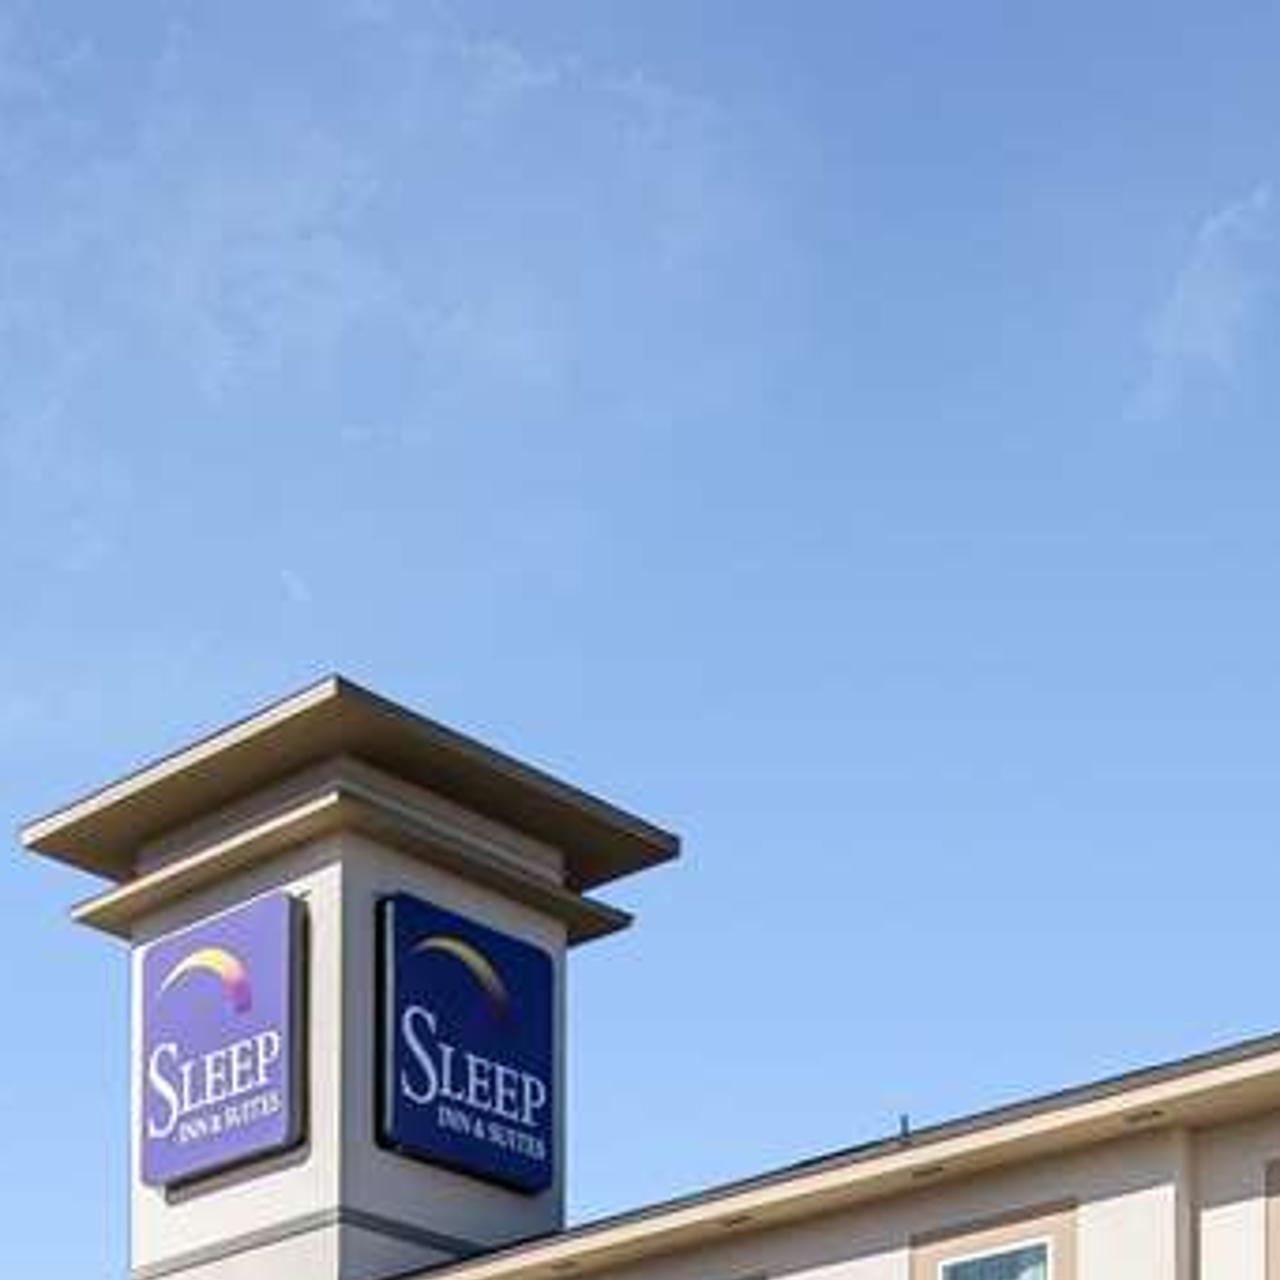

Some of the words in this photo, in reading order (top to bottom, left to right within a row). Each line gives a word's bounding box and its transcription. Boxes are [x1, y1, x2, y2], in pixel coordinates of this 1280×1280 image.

[149, 1031, 281, 1138] SLEEP
[401, 1005, 546, 1128] SLEEP
[438, 1104, 471, 1135] INN
